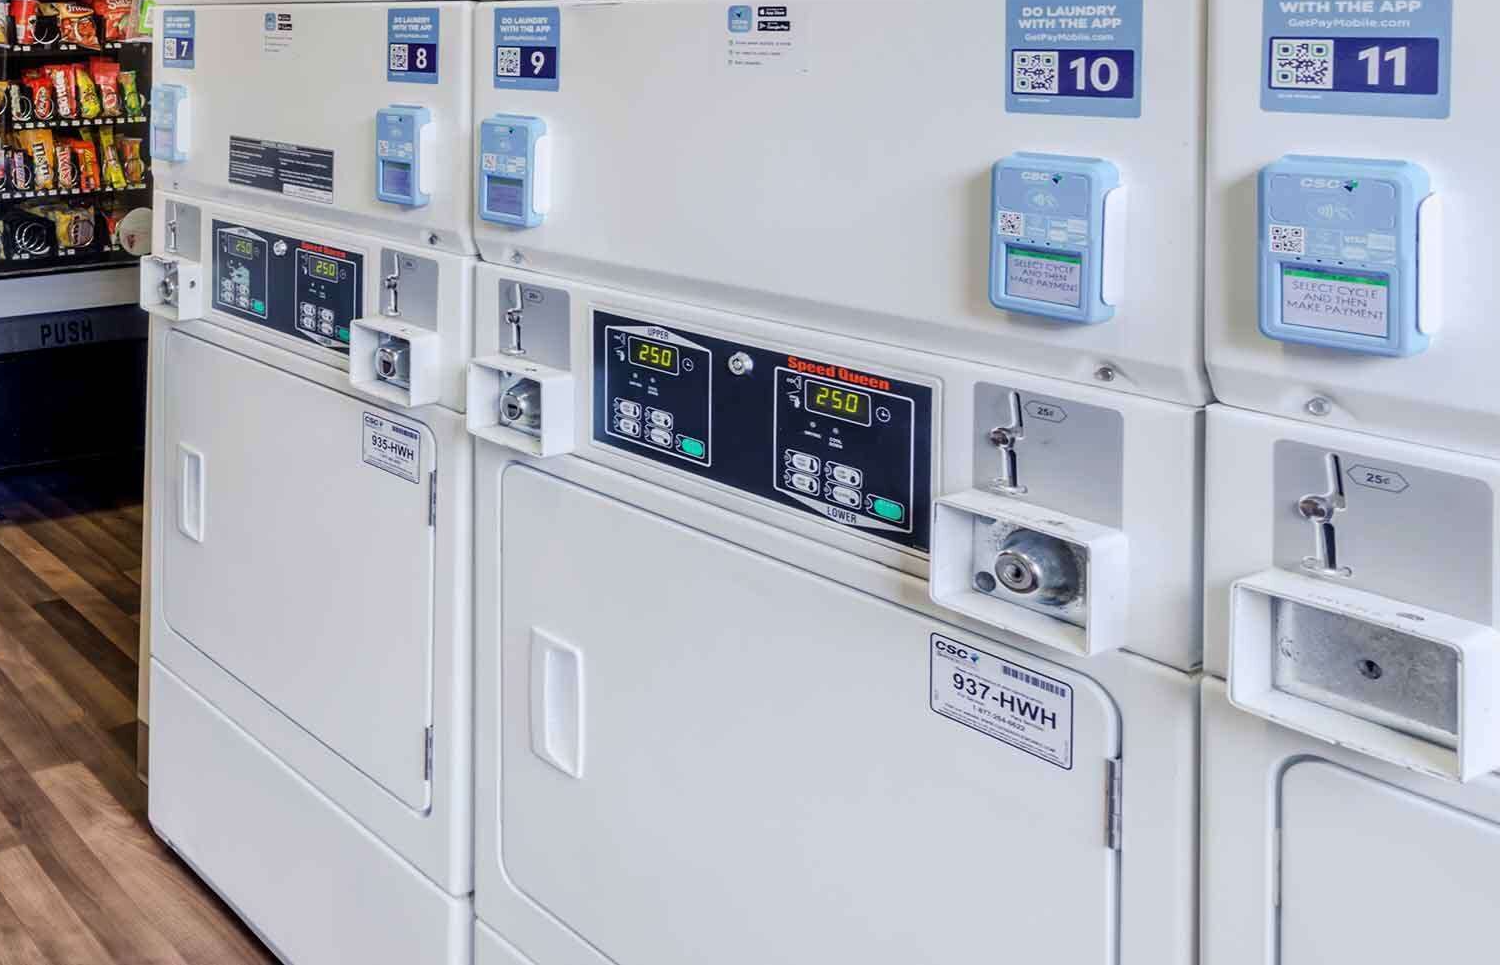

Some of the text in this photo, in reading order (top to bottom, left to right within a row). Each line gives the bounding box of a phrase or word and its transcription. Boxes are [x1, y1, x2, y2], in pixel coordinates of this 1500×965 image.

[1022, 4, 1117, 16] DO LAUNDRY
[1278, 0, 1422, 13] WITH THE APP
[1018, 17, 1122, 29] WITH THE APP
[1288, 18, 1411, 29] GetPayMobile.com
[180, 41, 189, 57] 7
[415, 47, 427, 69] 8
[530, 51, 545, 75] 9
[1357, 46, 1407, 86] 11
[1069, 56, 1119, 92] 10
[1300, 178, 1341, 188] CSC
[235, 239, 252, 254] 250
[315, 260, 336, 277] 250
[1292, 281, 1378, 299] SELECT CYCLE
[1303, 293, 1368, 307] AND THEN
[1286, 300, 1384, 321] MAKE PAYMENT
[40, 318, 94, 347] PUSH
[647, 327, 669, 340] UPPER
[639, 344, 672, 367] 250
[787, 355, 891, 390] Speed Queen
[816, 387, 859, 413] 250
[371, 435, 414, 460] 935-HWH
[827, 506, 857, 524] LOWER
[935, 640, 969, 659] CSC
[953, 673, 1056, 729] 937-HWH
